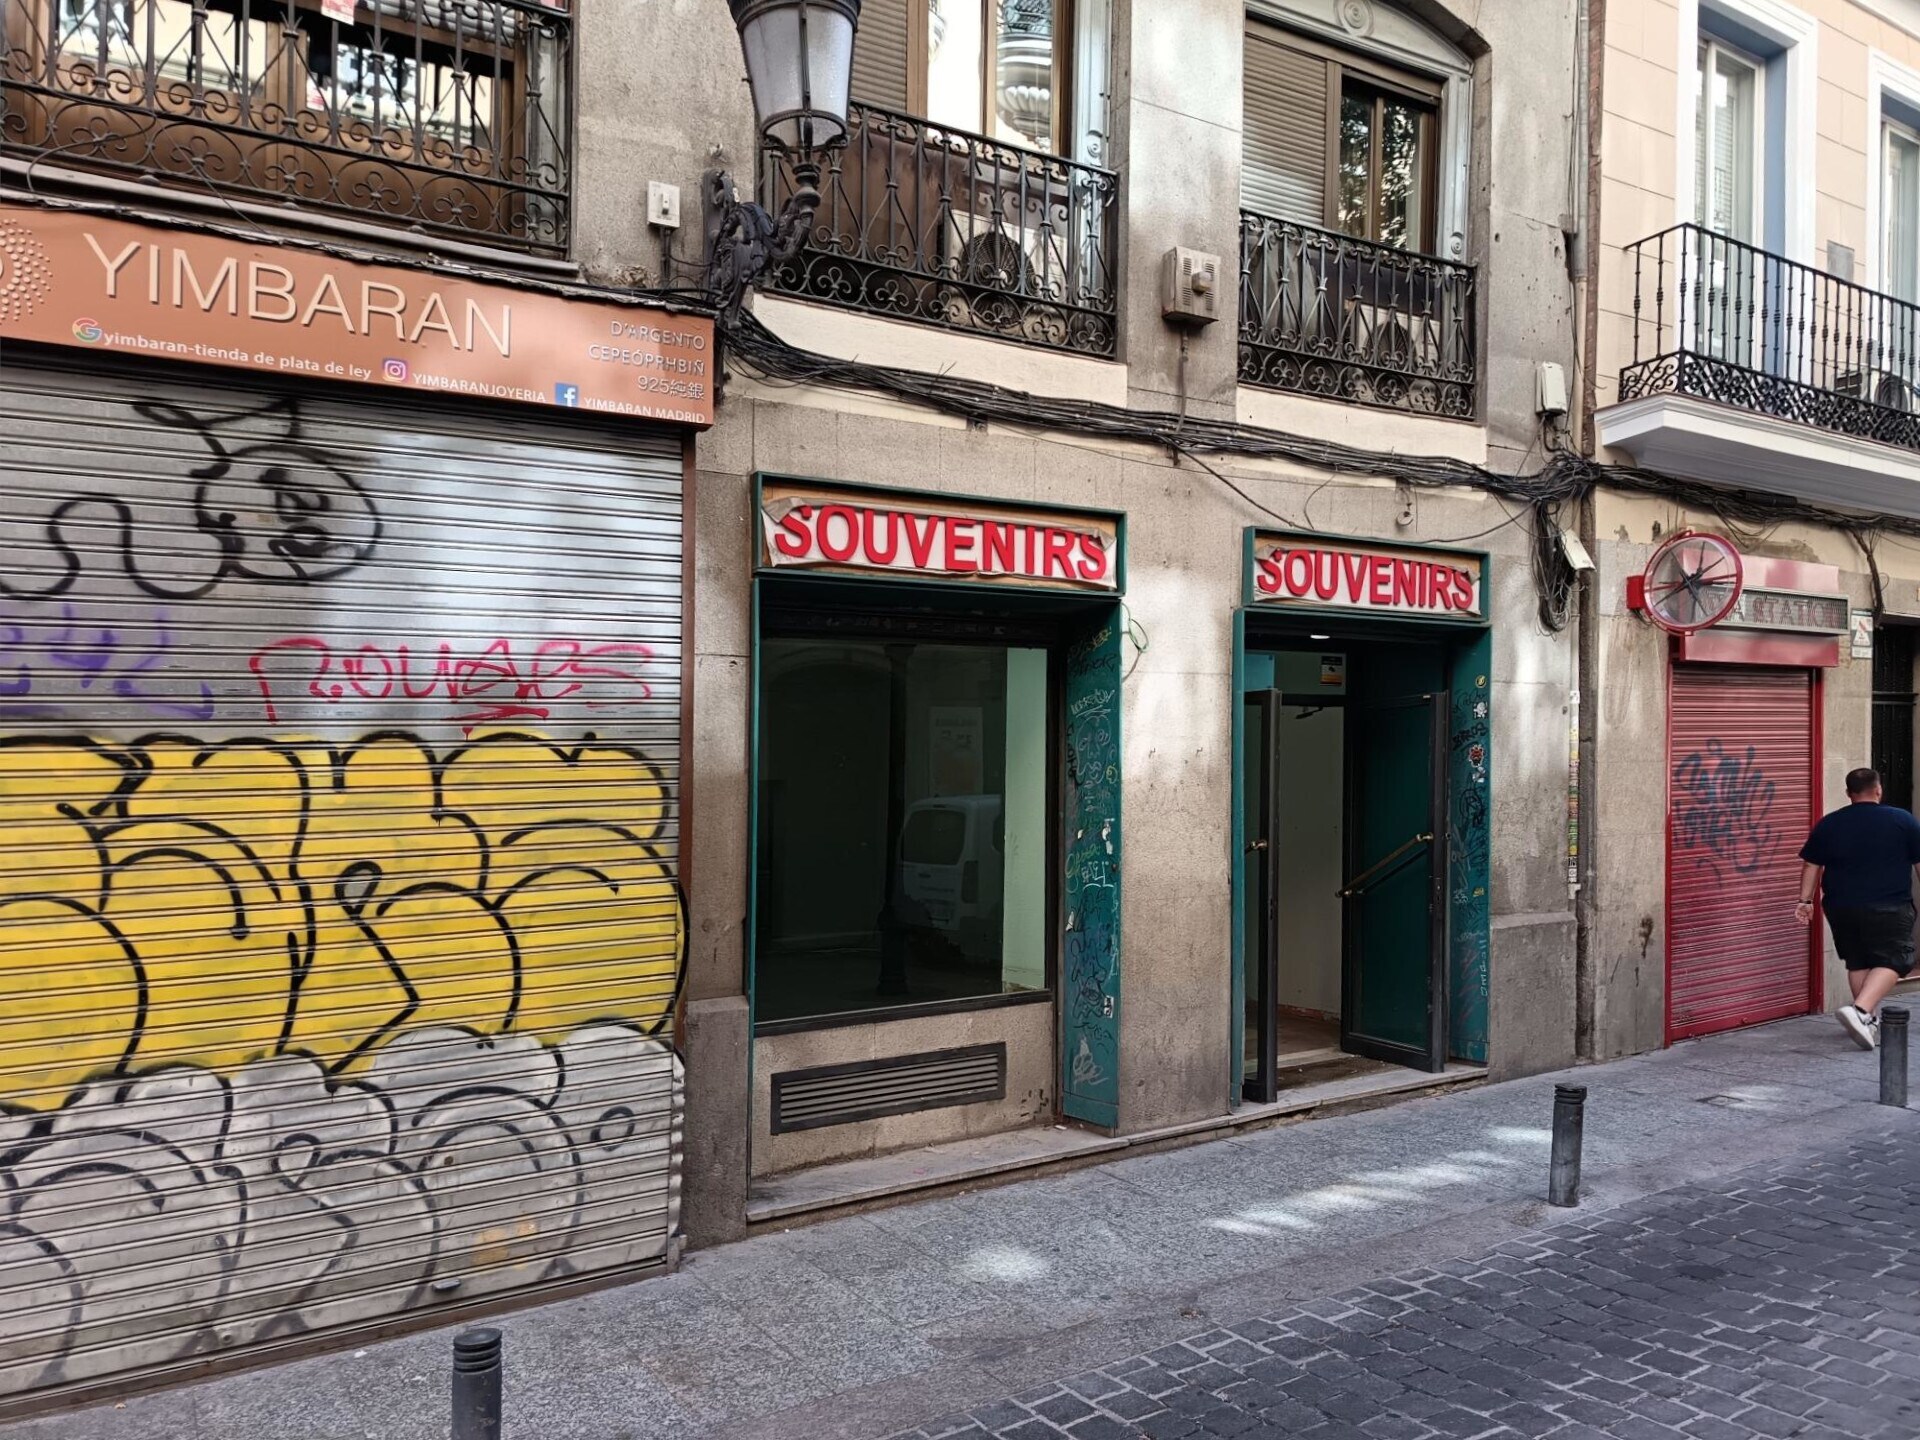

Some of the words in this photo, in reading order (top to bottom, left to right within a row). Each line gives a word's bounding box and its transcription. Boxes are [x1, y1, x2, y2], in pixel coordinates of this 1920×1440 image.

[83, 233, 511, 357] YIMBARAN
[104, 331, 249, 363] yimbaran-tienda
[254, 351, 274, 366] de
[280, 355, 320, 371] plata
[325, 360, 344, 375] de
[349, 364, 371, 381] ley
[413, 373, 547, 402] YIMBARANJOYERIA
[584, 397, 652, 416] YIMBARAN
[655, 408, 706, 424] MADRID
[774, 503, 1107, 580] SOUVENIRS
[1256, 547, 1474, 610] SOUVENIRS
